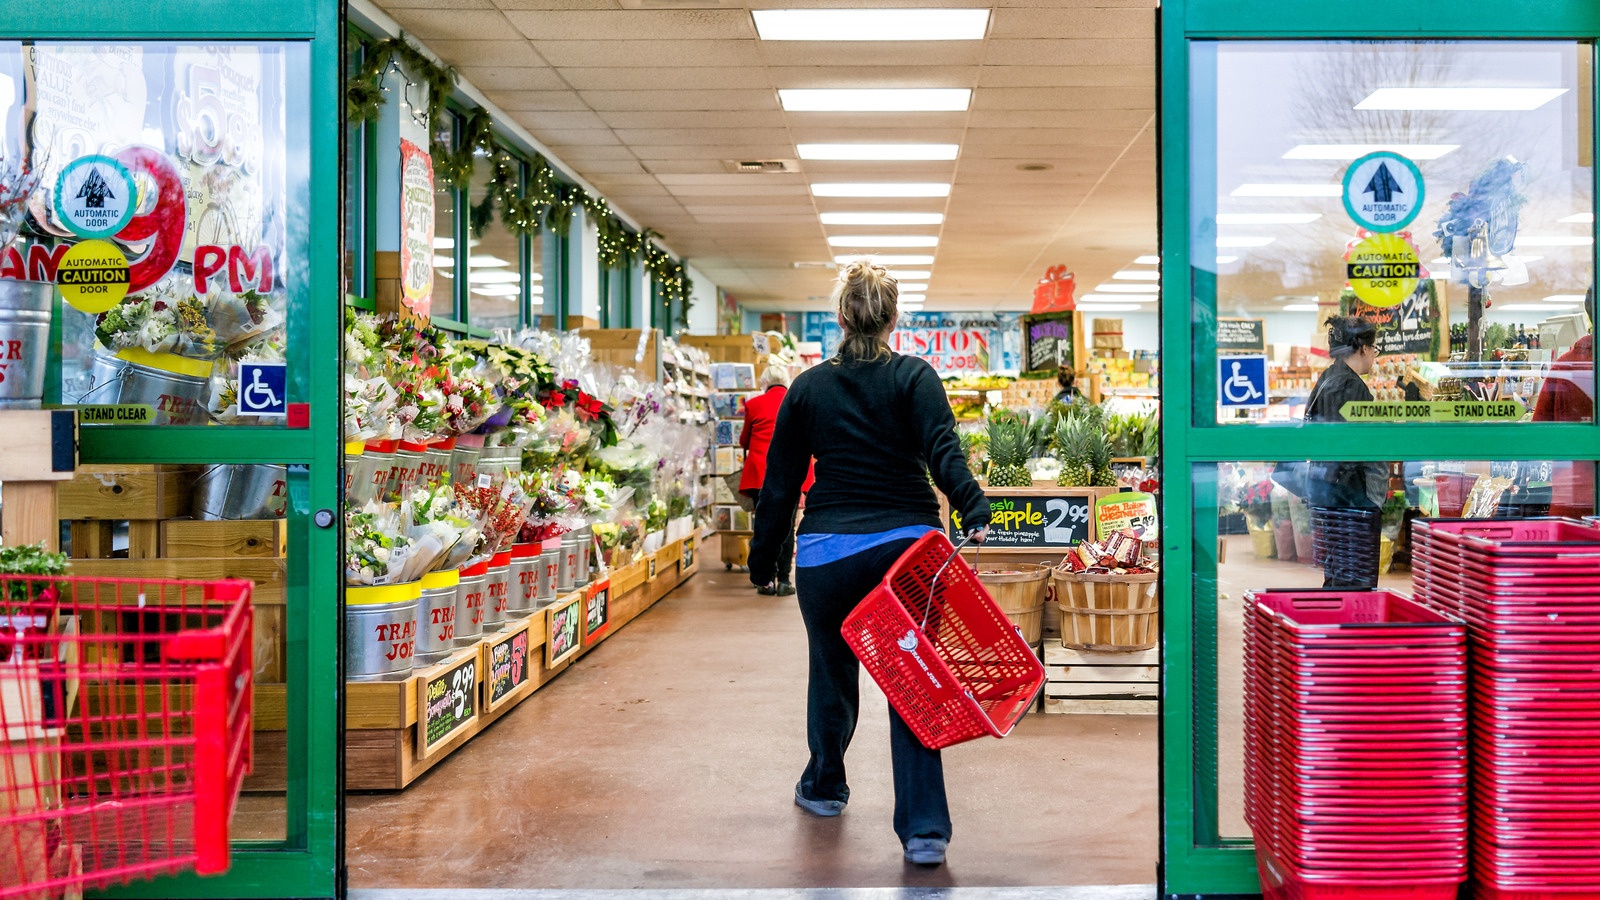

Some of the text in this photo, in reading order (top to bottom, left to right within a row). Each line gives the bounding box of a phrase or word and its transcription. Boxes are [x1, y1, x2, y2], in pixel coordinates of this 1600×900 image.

[30, 64, 72, 96] VALUE
[1362, 204, 1407, 212] AUTOMATIC
[74, 209, 119, 218] AUTOMATIC
[1373, 213, 1396, 221] DOOR
[85, 218, 108, 227] DOOR
[66, 257, 122, 267] AUTOMATIC
[1356, 253, 1412, 261] AUTOMATIC
[193, 244, 274, 293] PM
[1352, 264, 1416, 277] CAUTION
[62, 270, 126, 283] CAUTION
[80, 284, 108, 294] DOOR
[1370, 280, 1398, 288] DOOR
[894, 330, 990, 354] ESTON
[84, 408, 147, 420] STAND CLEAR
[1350, 405, 1403, 417] AUTOMATIC
[1405, 405, 1431, 417] DOOR
[1454, 405, 1484, 417] STAND
[1487, 405, 1516, 417] CLEAR
[1101, 503, 1120, 513] Fresh
[1042, 498, 1089, 544] $2.99
[1014, 530, 1040, 538] pineapple
